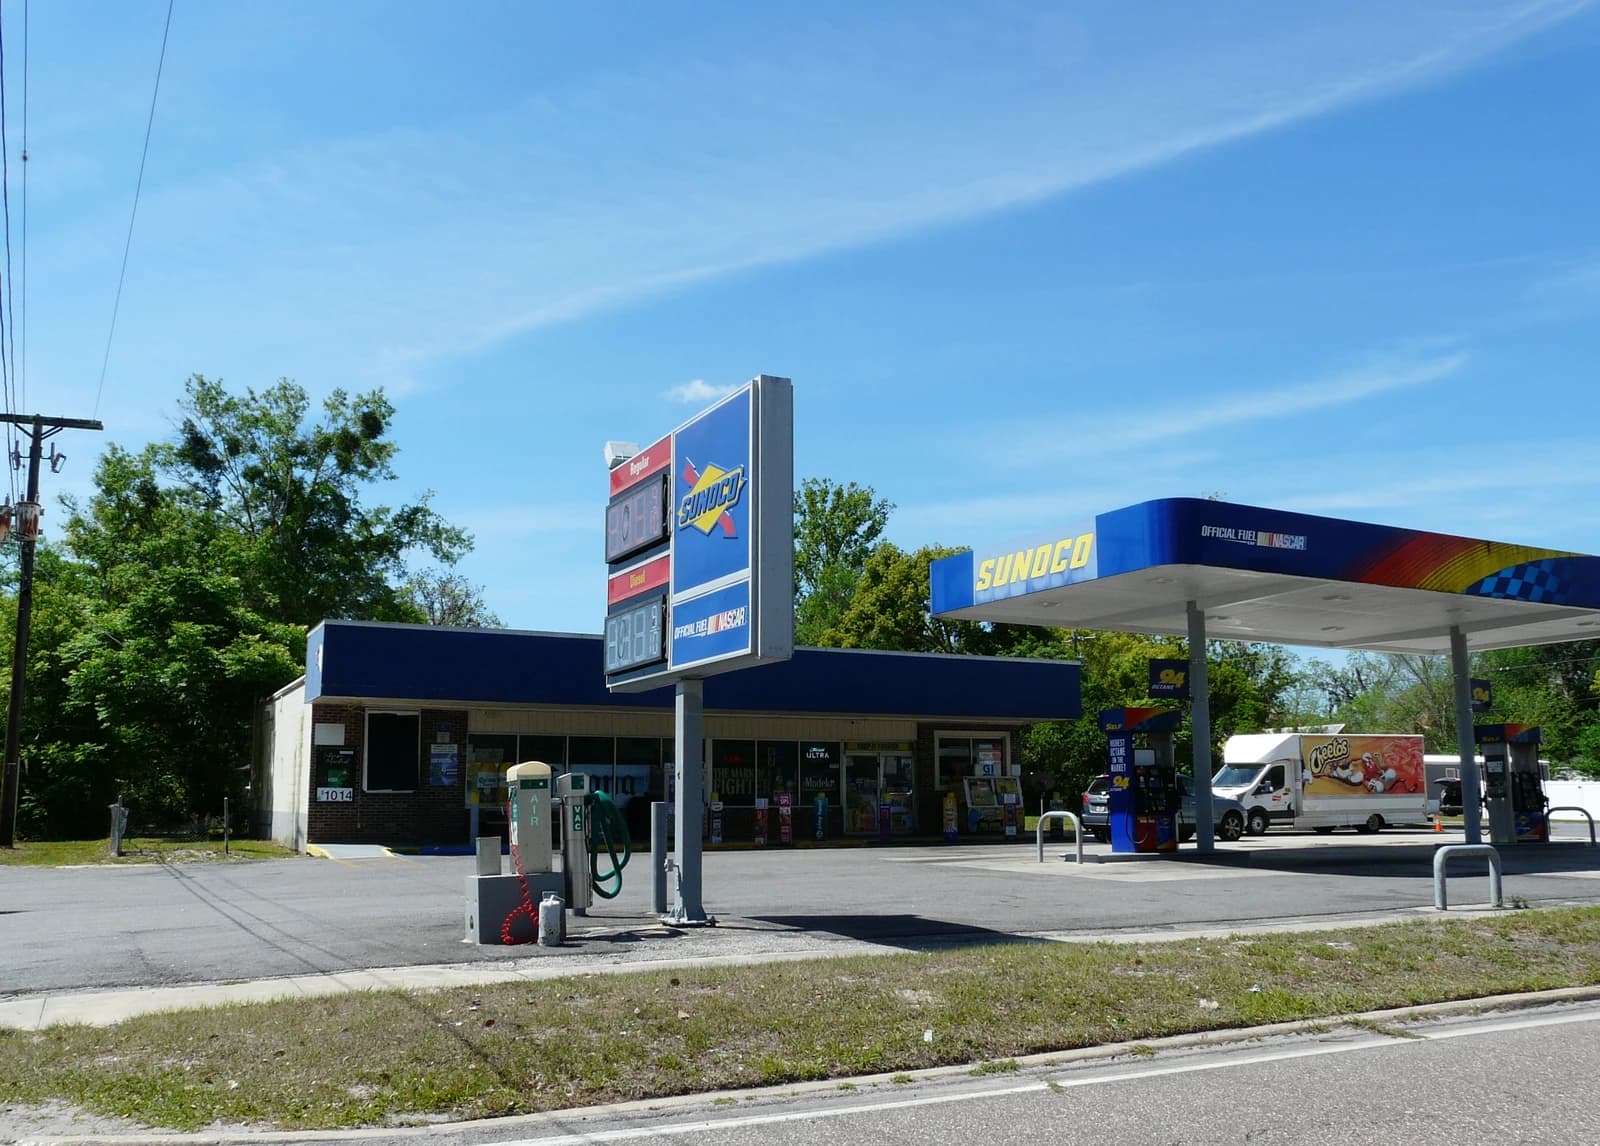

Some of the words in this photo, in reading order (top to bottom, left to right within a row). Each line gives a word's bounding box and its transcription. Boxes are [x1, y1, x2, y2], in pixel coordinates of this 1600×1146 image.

[630, 456, 649, 476] Regular
[680, 472, 741, 525] SUNOCO
[1201, 525, 1236, 540] OFFICIAL
[1238, 529, 1256, 541] FUEL
[1272, 533, 1306, 551] NASCAR
[975, 532, 1094, 592] SUNOCO
[629, 570, 646, 588] Diesel
[674, 622, 696, 640] OFFICIAL
[696, 618, 708, 632] FUEL
[718, 606, 746, 632] NASCAR
[1159, 668, 1185, 688] 94
[1310, 737, 1349, 773] Cheetos
[1113, 775, 1130, 790] 94
[530, 794, 539, 827] AIR
[573, 806, 582, 830] VAC
